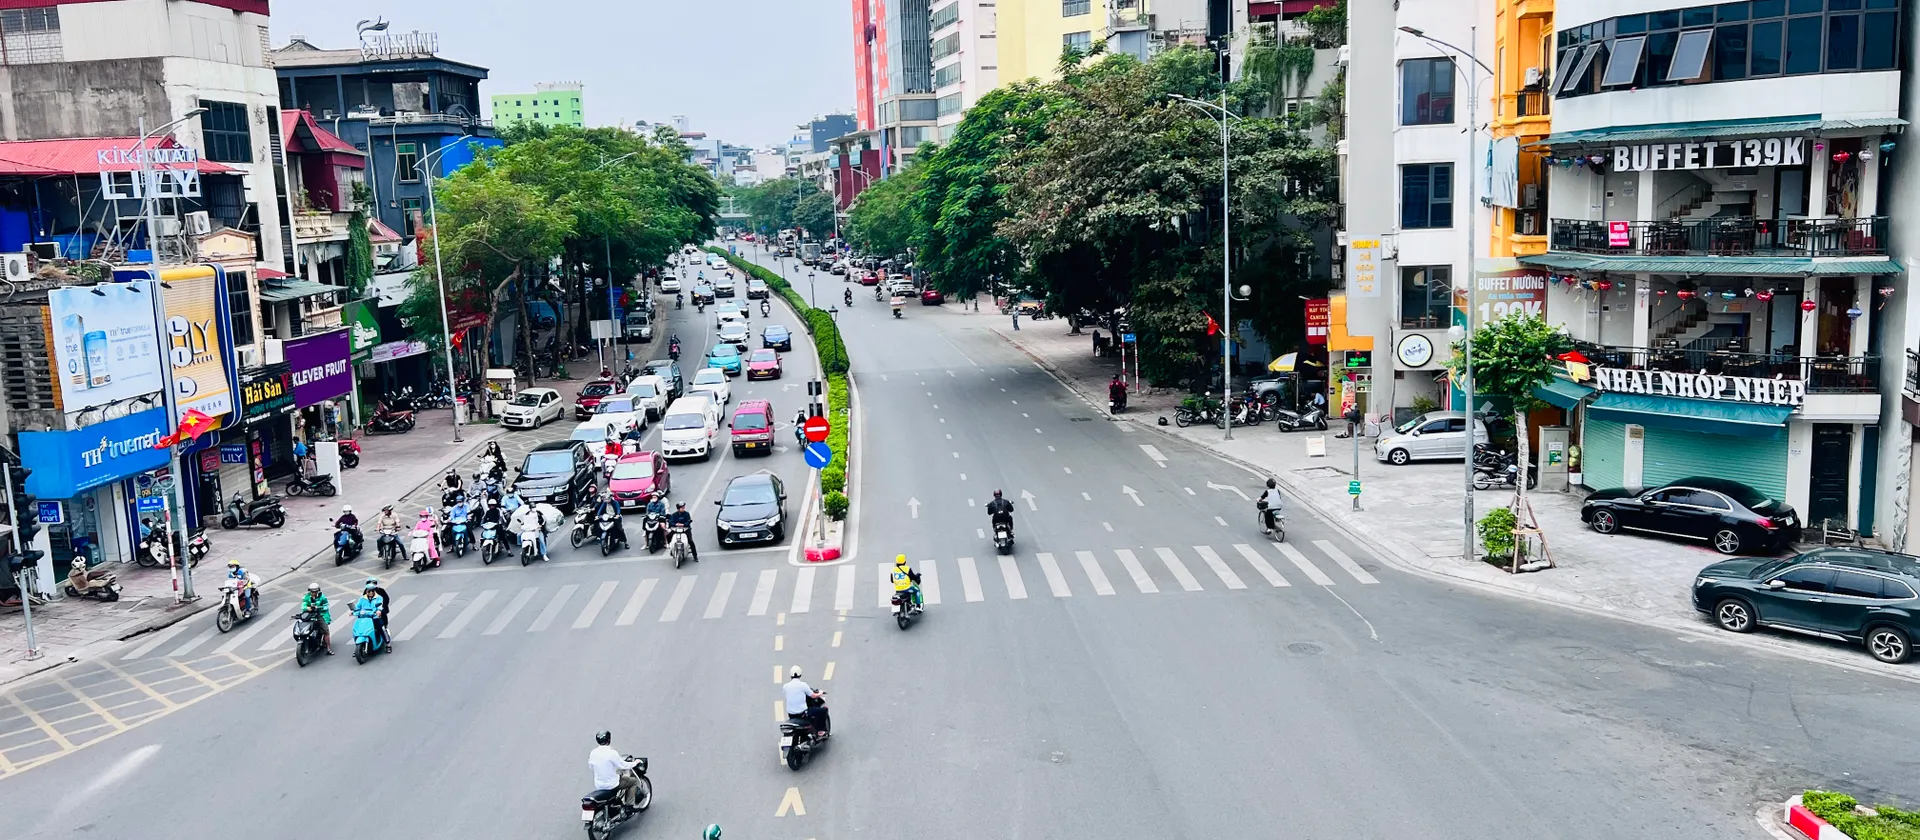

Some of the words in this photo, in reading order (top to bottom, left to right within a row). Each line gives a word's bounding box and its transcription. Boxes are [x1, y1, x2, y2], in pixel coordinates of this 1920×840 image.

[1613, 140, 1718, 172] BUFFET
[1730, 136, 1804, 168] 139K
[1478, 276, 1511, 291] BUFFET
[1512, 274, 1545, 290] NƯỚNG
[291, 365, 325, 387] KLEVER
[325, 358, 347, 378] FRUIT
[244, 382, 263, 405] Hải
[1660, 367, 1727, 400] NHÓP
[1732, 372, 1806, 406] NHÉP
[81, 447, 103, 468] TH
[221, 452, 243, 463] LILY
[39, 508, 57, 516] true
[41, 514, 58, 522] mart
